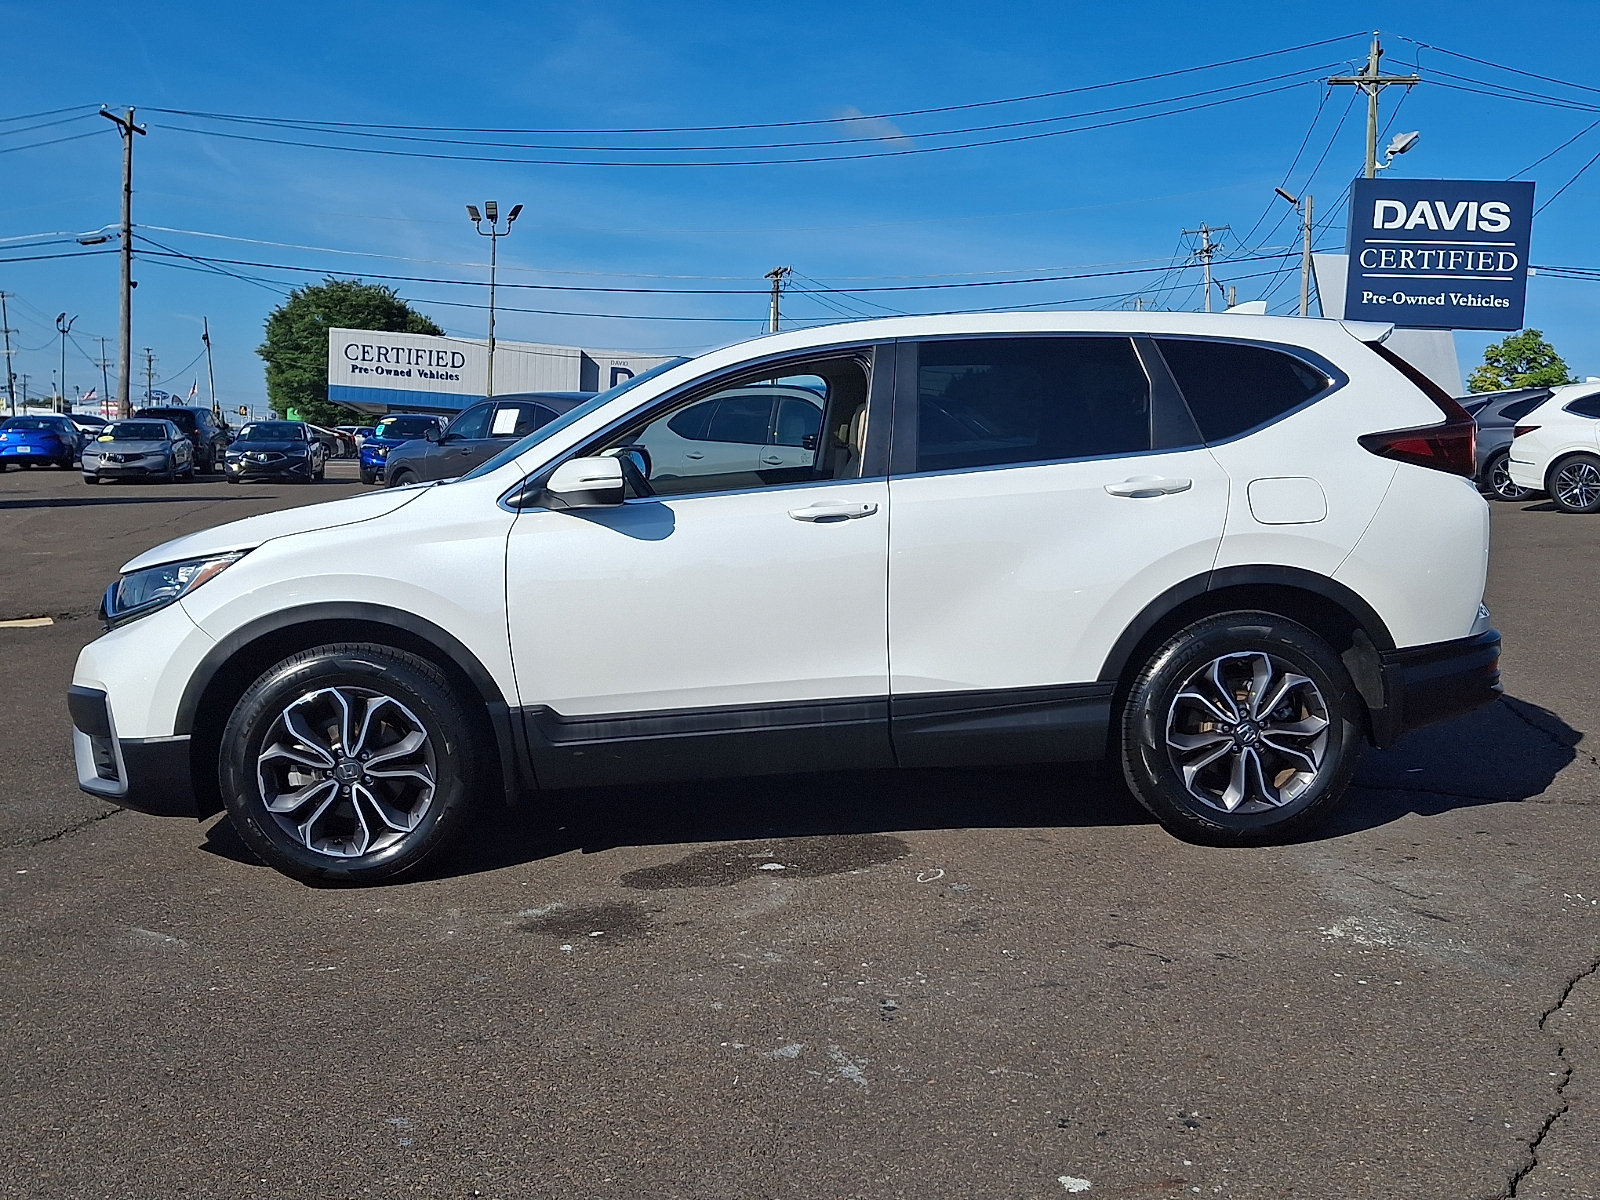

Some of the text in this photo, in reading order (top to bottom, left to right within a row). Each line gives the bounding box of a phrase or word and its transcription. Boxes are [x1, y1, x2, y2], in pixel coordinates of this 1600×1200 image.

[1373, 200, 1511, 232] DAVIS
[1359, 248, 1519, 272] CERTIFIED
[1361, 291, 1510, 308] Pre-Owned Vehicles
[344, 343, 466, 369] CERTIFIED
[351, 364, 460, 381] Pre-Owned Vehicles
